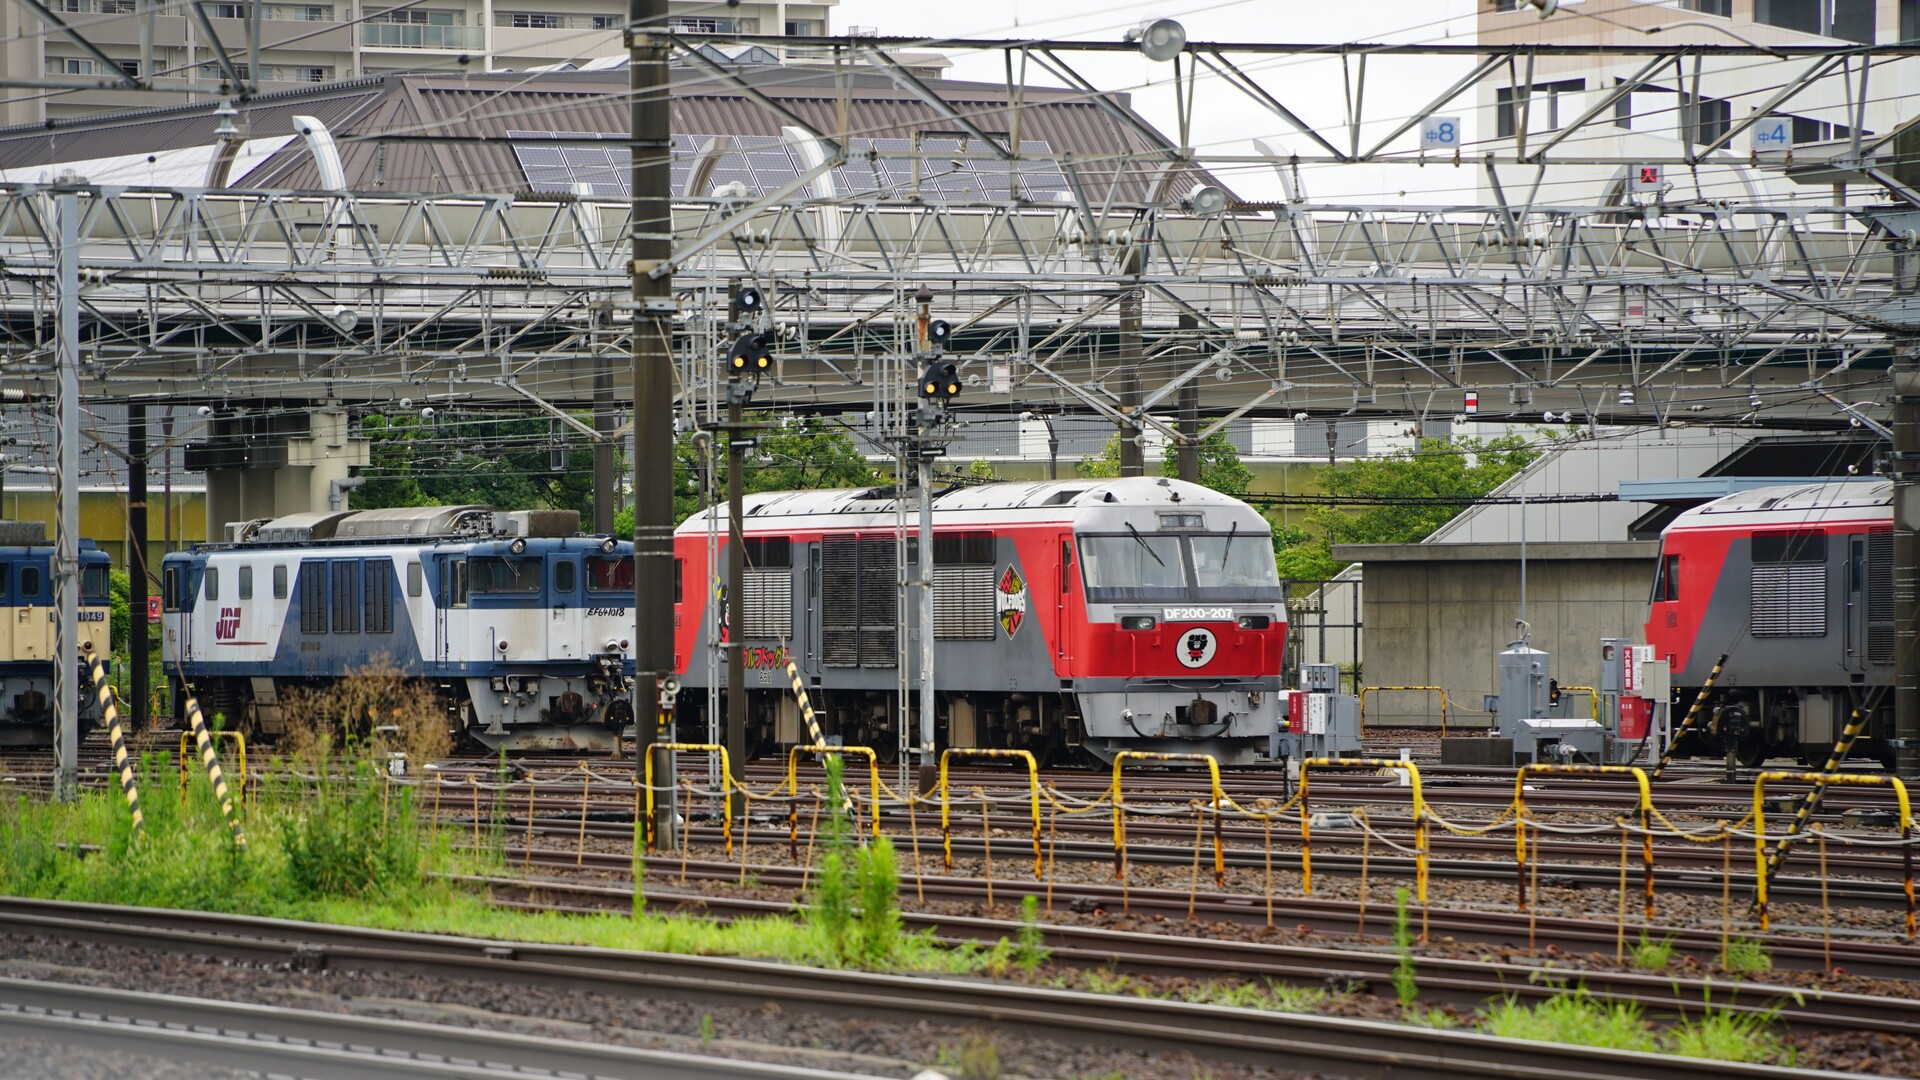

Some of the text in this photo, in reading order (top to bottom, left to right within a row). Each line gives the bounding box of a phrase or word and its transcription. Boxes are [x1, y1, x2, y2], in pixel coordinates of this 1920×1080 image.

[1426, 122, 1454, 143] 中8
[1758, 124, 1786, 144] 中4
[1164, 608, 1233, 619] DF200-207
